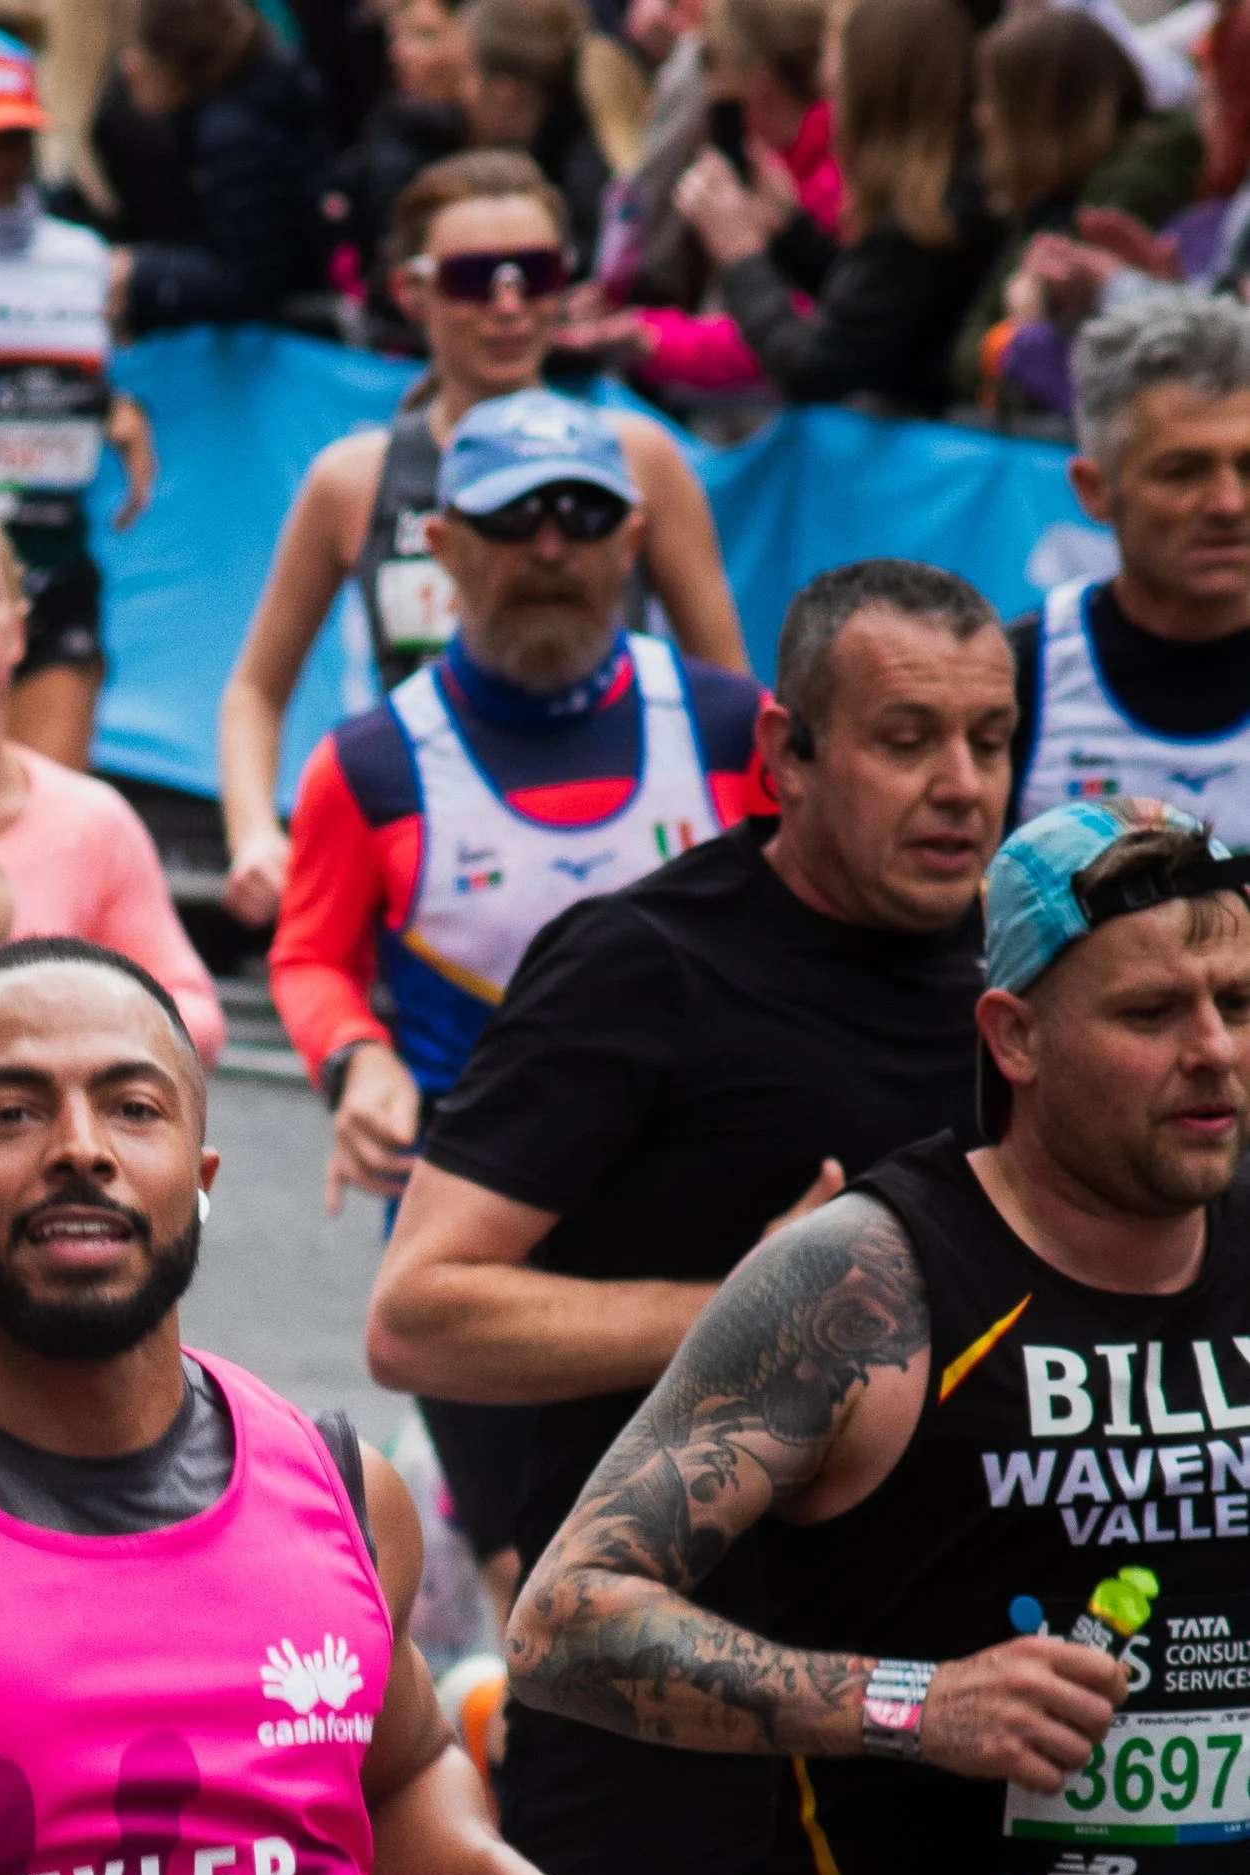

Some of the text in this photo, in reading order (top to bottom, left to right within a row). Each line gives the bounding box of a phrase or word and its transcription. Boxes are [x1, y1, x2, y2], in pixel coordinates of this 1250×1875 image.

[1060, 1494, 1250, 1546] VALLE
[1166, 1615, 1231, 1639] TATA
[1063, 1735, 1250, 1812] 3697
